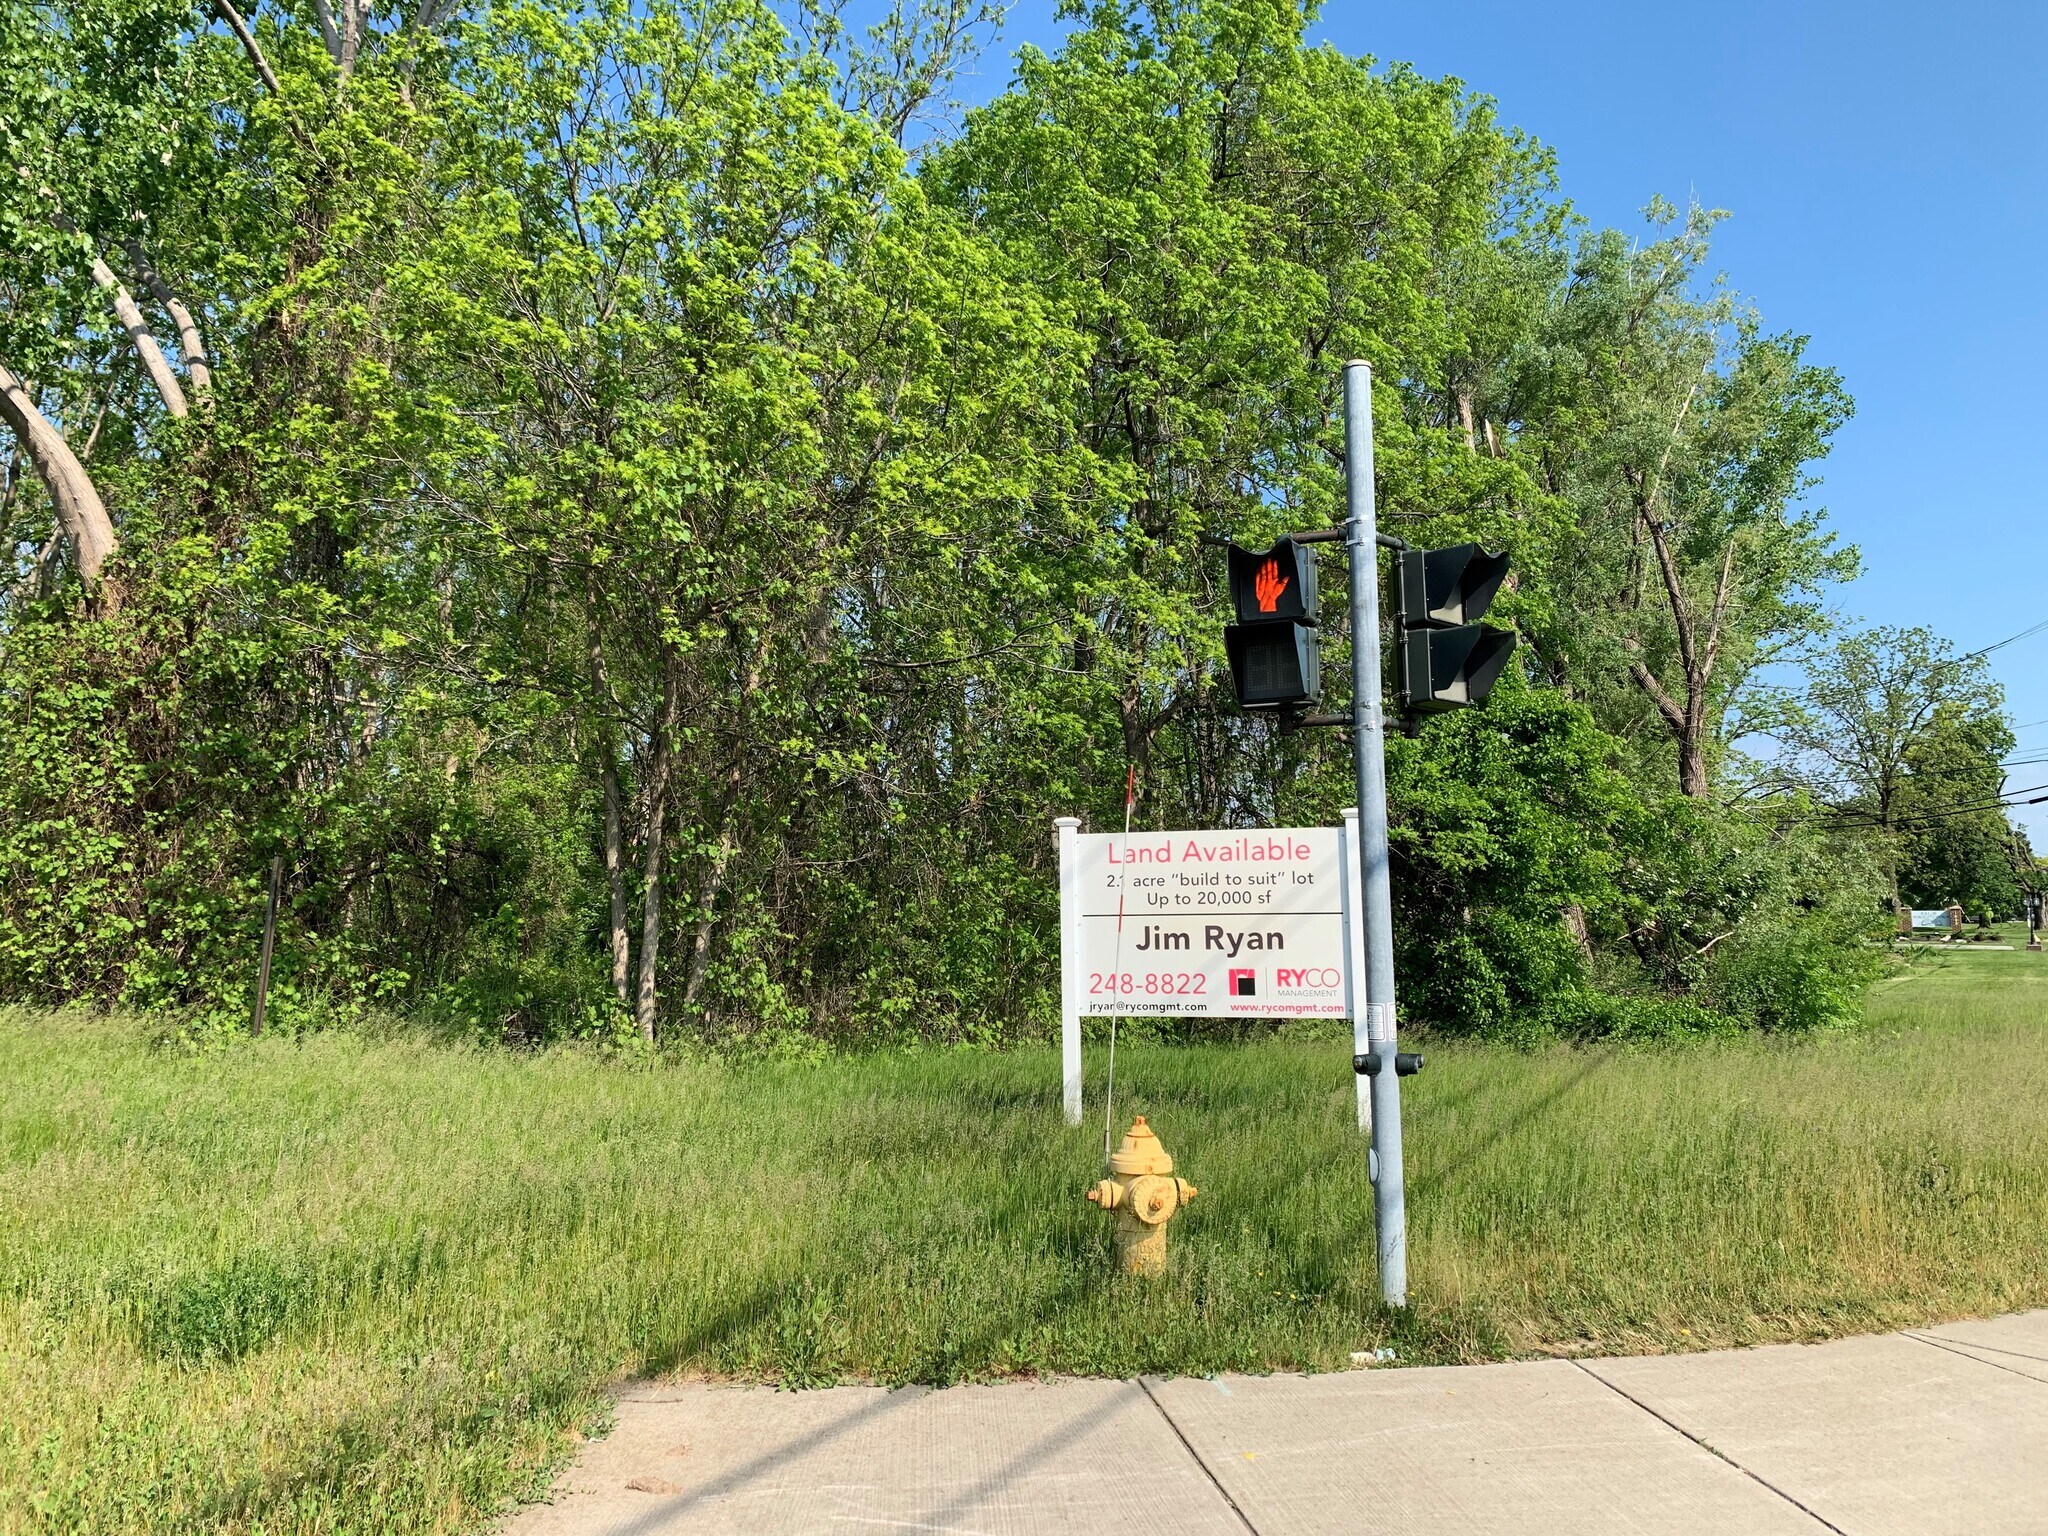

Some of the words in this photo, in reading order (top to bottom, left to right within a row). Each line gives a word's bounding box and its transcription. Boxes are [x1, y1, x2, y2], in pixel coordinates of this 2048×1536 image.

[1108, 840, 1171, 864] Land
[1182, 837, 1311, 862] Available
[1133, 876, 1165, 887] acre
[1225, 873, 1242, 885] to
[1292, 870, 1314, 885] lot
[1147, 892, 1169, 909] Up
[1174, 893, 1191, 905] to
[1197, 890, 1252, 907] 20,000
[1257, 890, 1272, 903] sf
[1136, 925, 1190, 951] Jim
[1205, 924, 1284, 958] Ryan
[1089, 973, 1207, 995] 248-8822
[1276, 968, 1341, 988] RYCO
[1277, 989, 1337, 997] MANAGEMENT
[1230, 1004, 1344, 1014] www.rycomgmt.com
